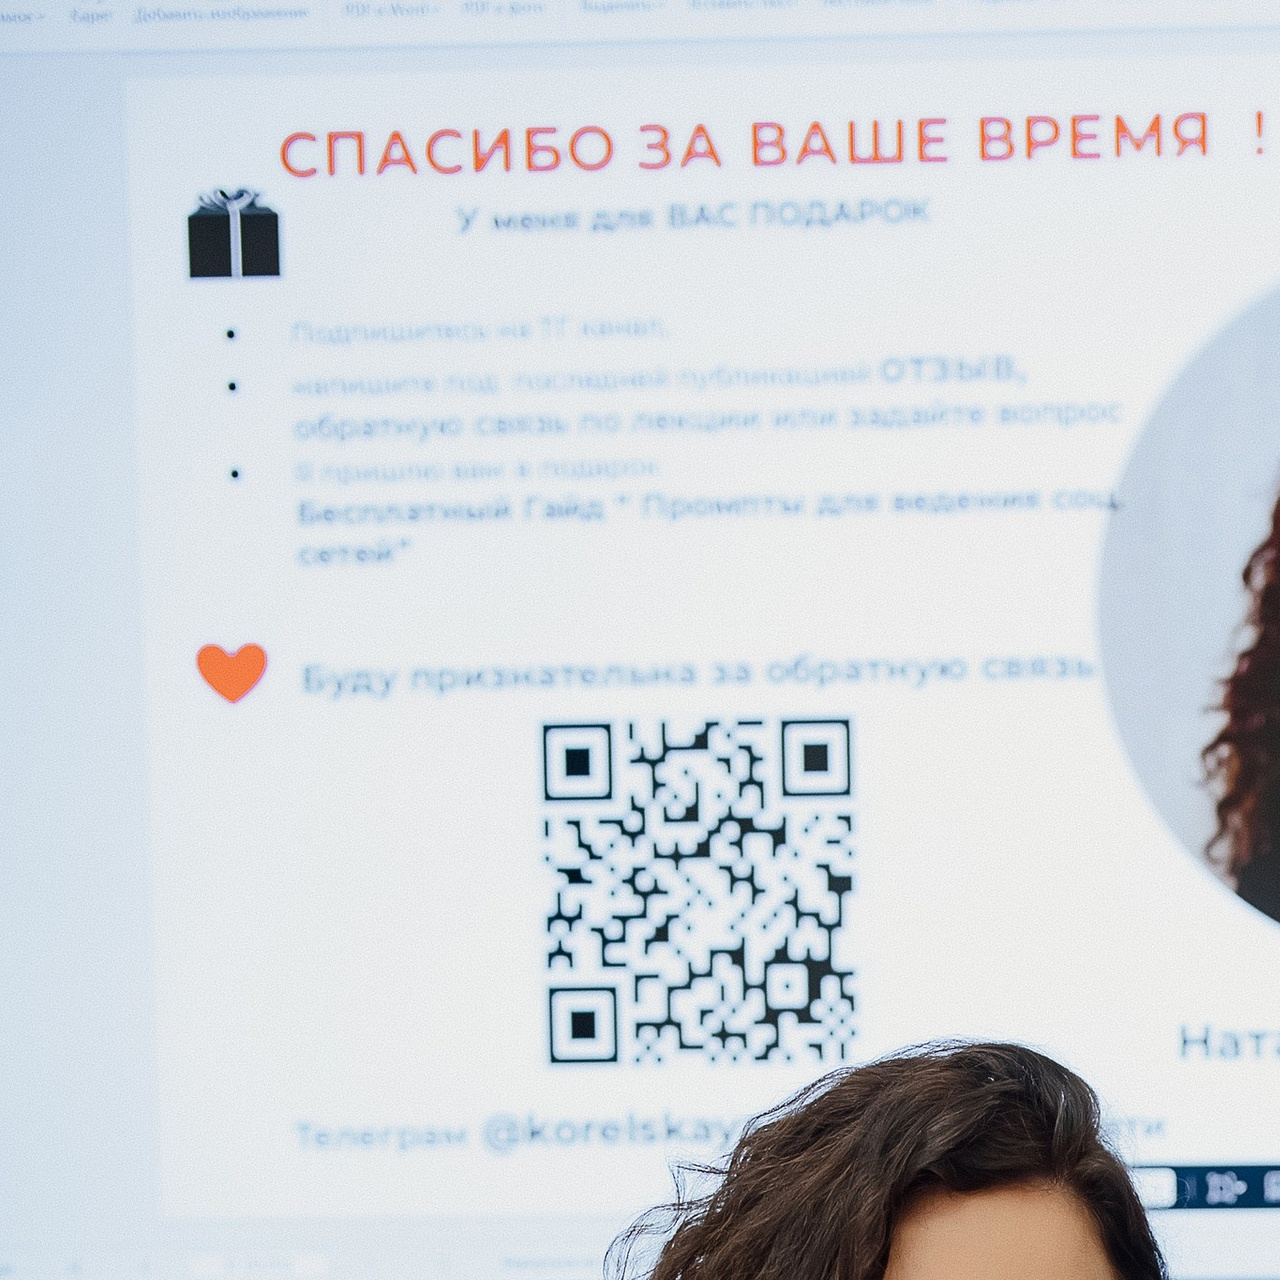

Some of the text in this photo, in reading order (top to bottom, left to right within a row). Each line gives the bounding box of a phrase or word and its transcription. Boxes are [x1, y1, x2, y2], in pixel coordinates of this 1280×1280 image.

[281, 111, 1264, 179] СПАСИБО ЗА ВАШЕ ВРЕМЯ !
[492, 212, 581, 234] меня
[590, 210, 656, 235] для
[667, 202, 738, 231] ВАС
[749, 198, 930, 231] ПОДАРОК
[877, 354, 1029, 386] ОТЗЫВ,
[294, 413, 465, 445] обратную
[474, 415, 570, 438] связь
[578, 412, 625, 436] по
[772, 409, 839, 431] или
[850, 401, 987, 431] задайте
[996, 402, 1123, 430] вопрос
[297, 497, 513, 528] Бесплатный
[524, 496, 607, 524] Гайд
[815, 494, 882, 519] для
[891, 491, 1039, 517] ведения
[302, 654, 1096, 702] Буду признательна за обратную связь
[296, 1110, 734, 1156] Телеграм @korelskay
